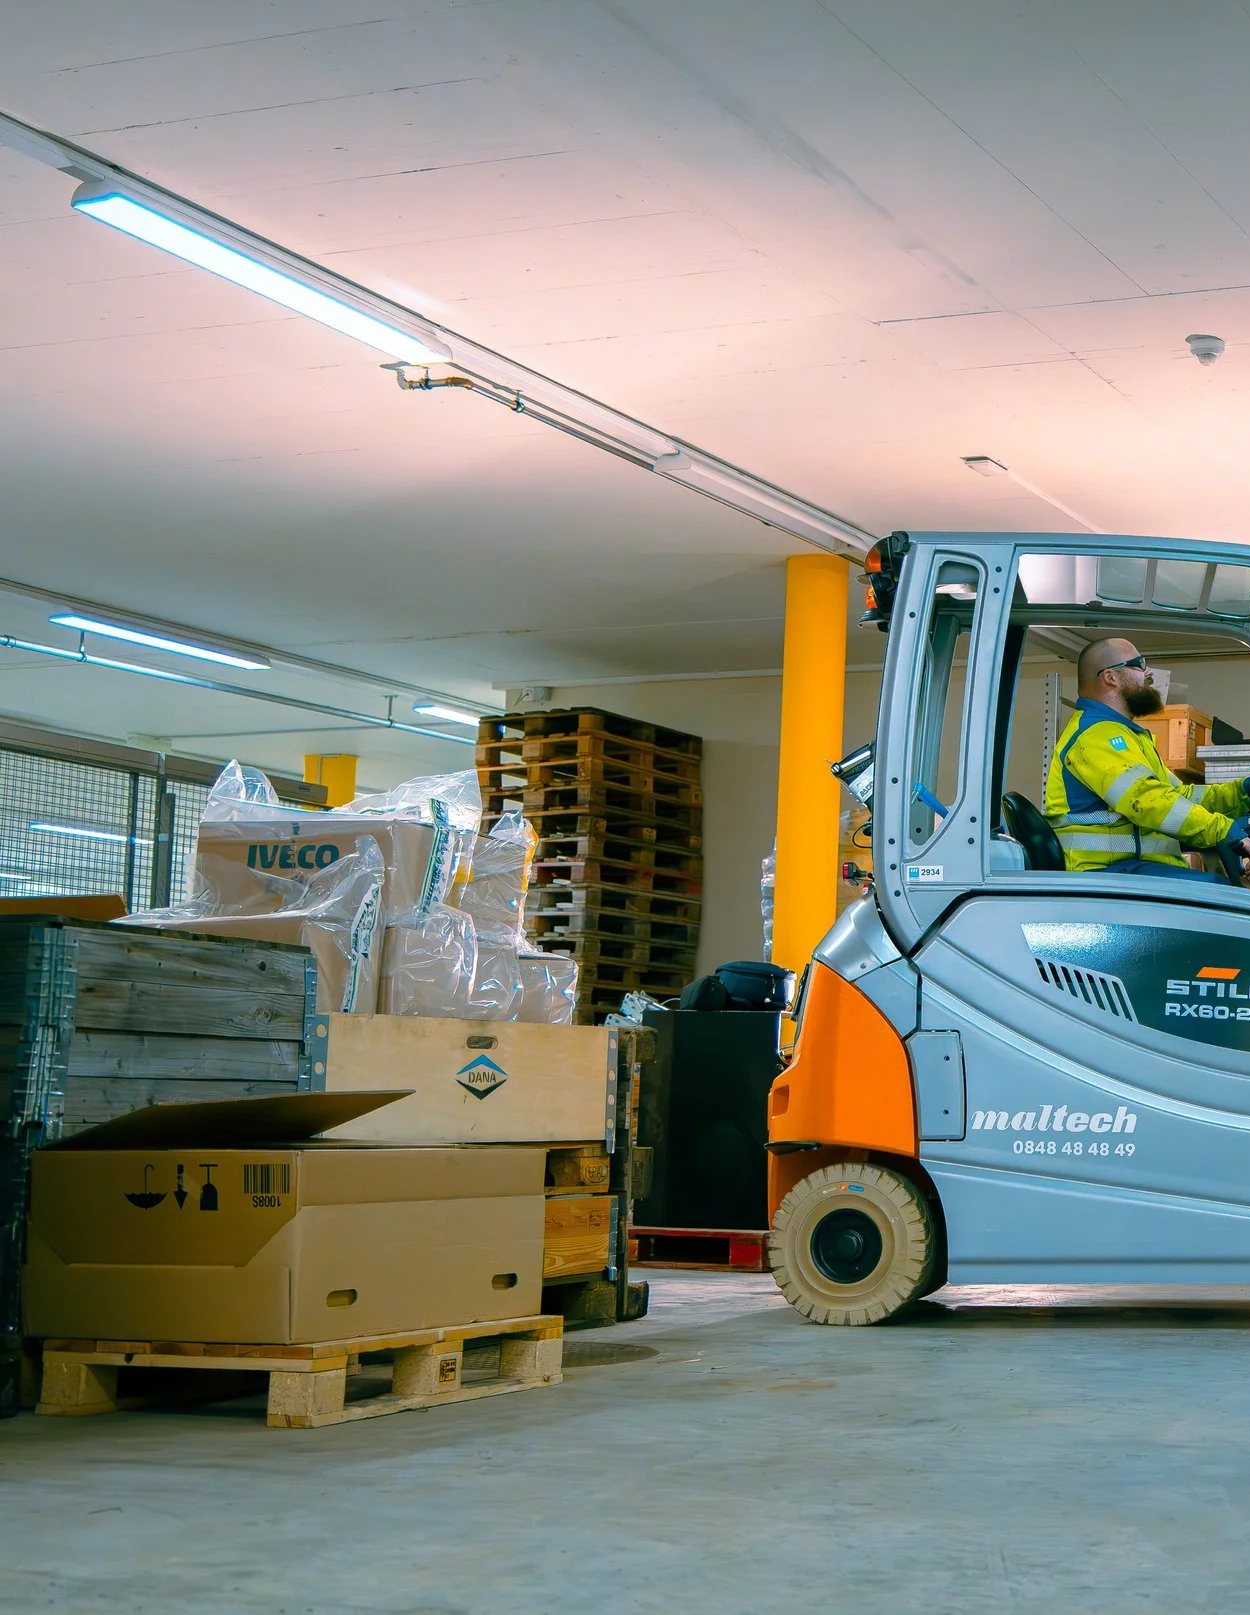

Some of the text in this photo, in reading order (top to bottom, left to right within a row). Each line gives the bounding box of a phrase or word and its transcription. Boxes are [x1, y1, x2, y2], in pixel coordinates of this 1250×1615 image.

[247, 844, 340, 869] IVECO
[921, 868, 941, 876] 2934
[468, 1071, 497, 1083] DANA
[970, 1104, 1138, 1133] maltech
[1013, 1140, 1136, 1157] 0848 48 48 49
